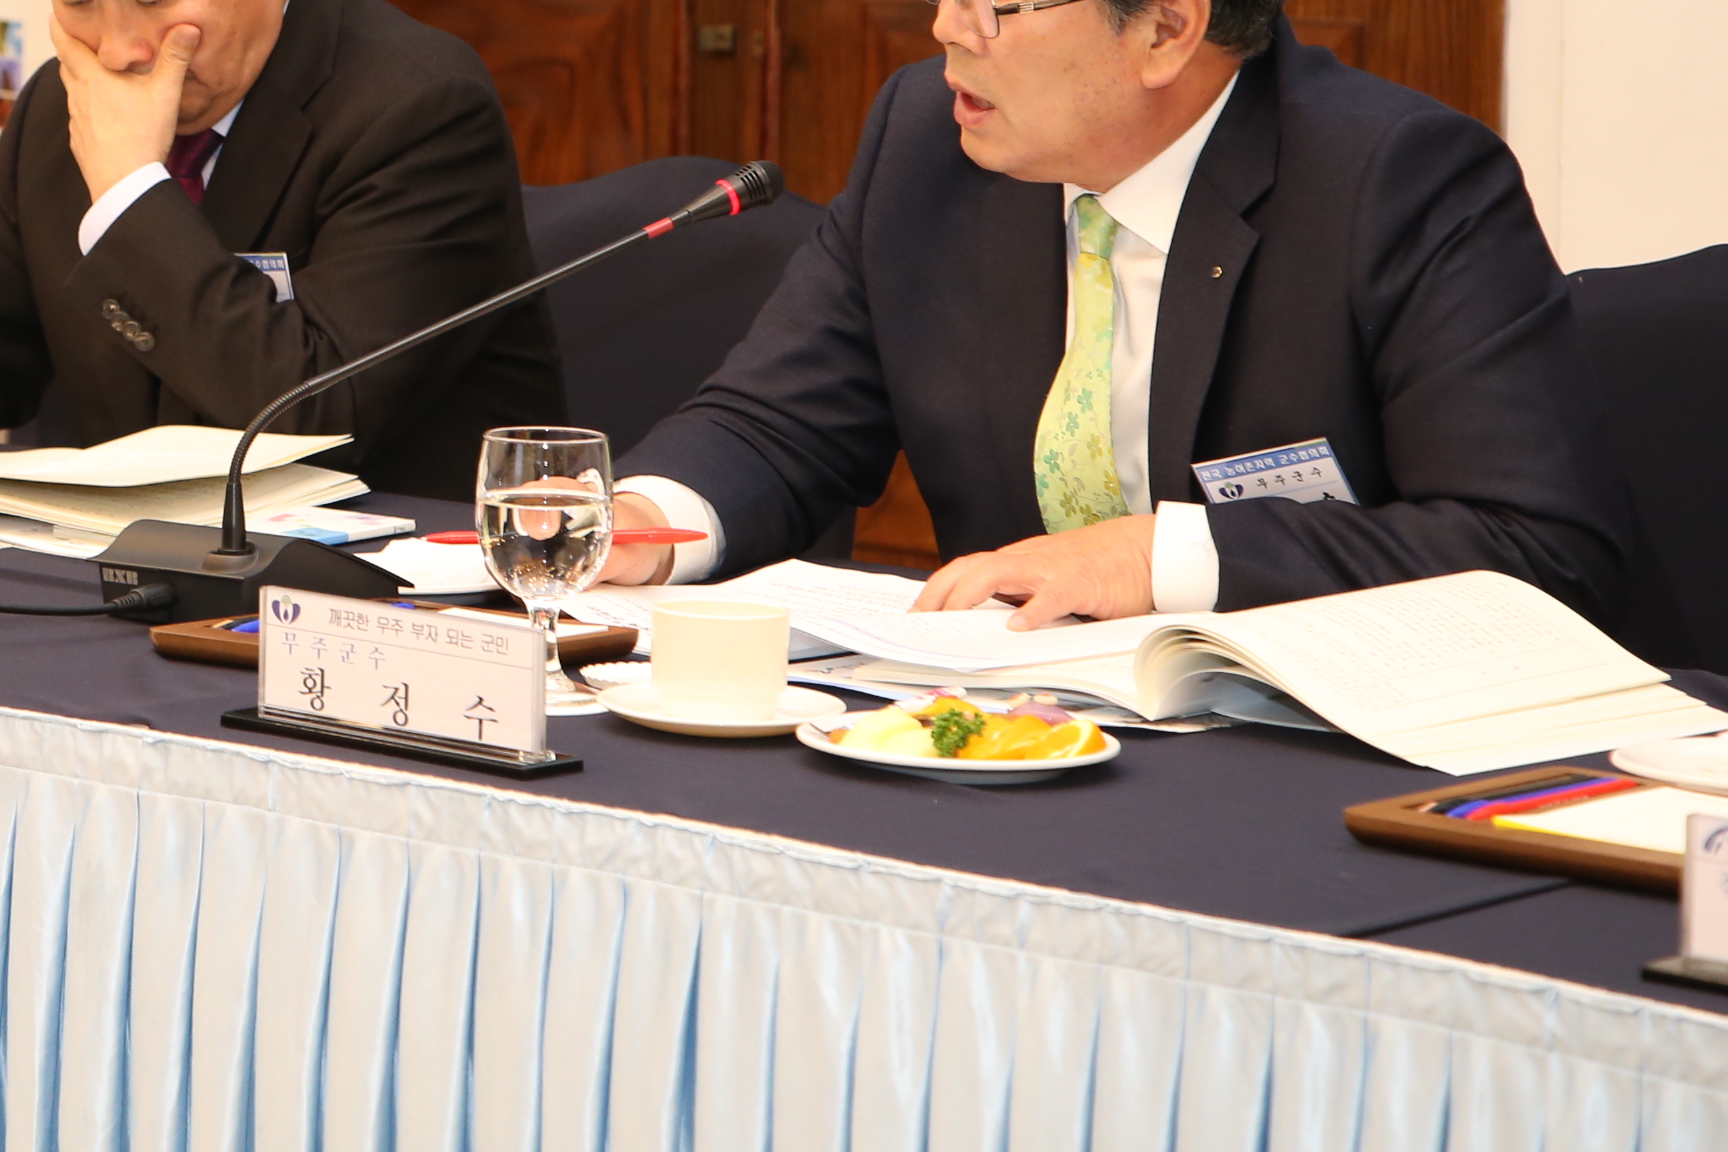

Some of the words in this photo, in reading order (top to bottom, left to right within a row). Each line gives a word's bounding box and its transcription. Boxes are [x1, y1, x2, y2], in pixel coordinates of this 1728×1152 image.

[328, 608, 370, 632] 깨끗한
[376, 616, 404, 637] 무주
[410, 622, 440, 644] 부자
[445, 628, 474, 650] 되는
[480, 633, 509, 656] 군민
